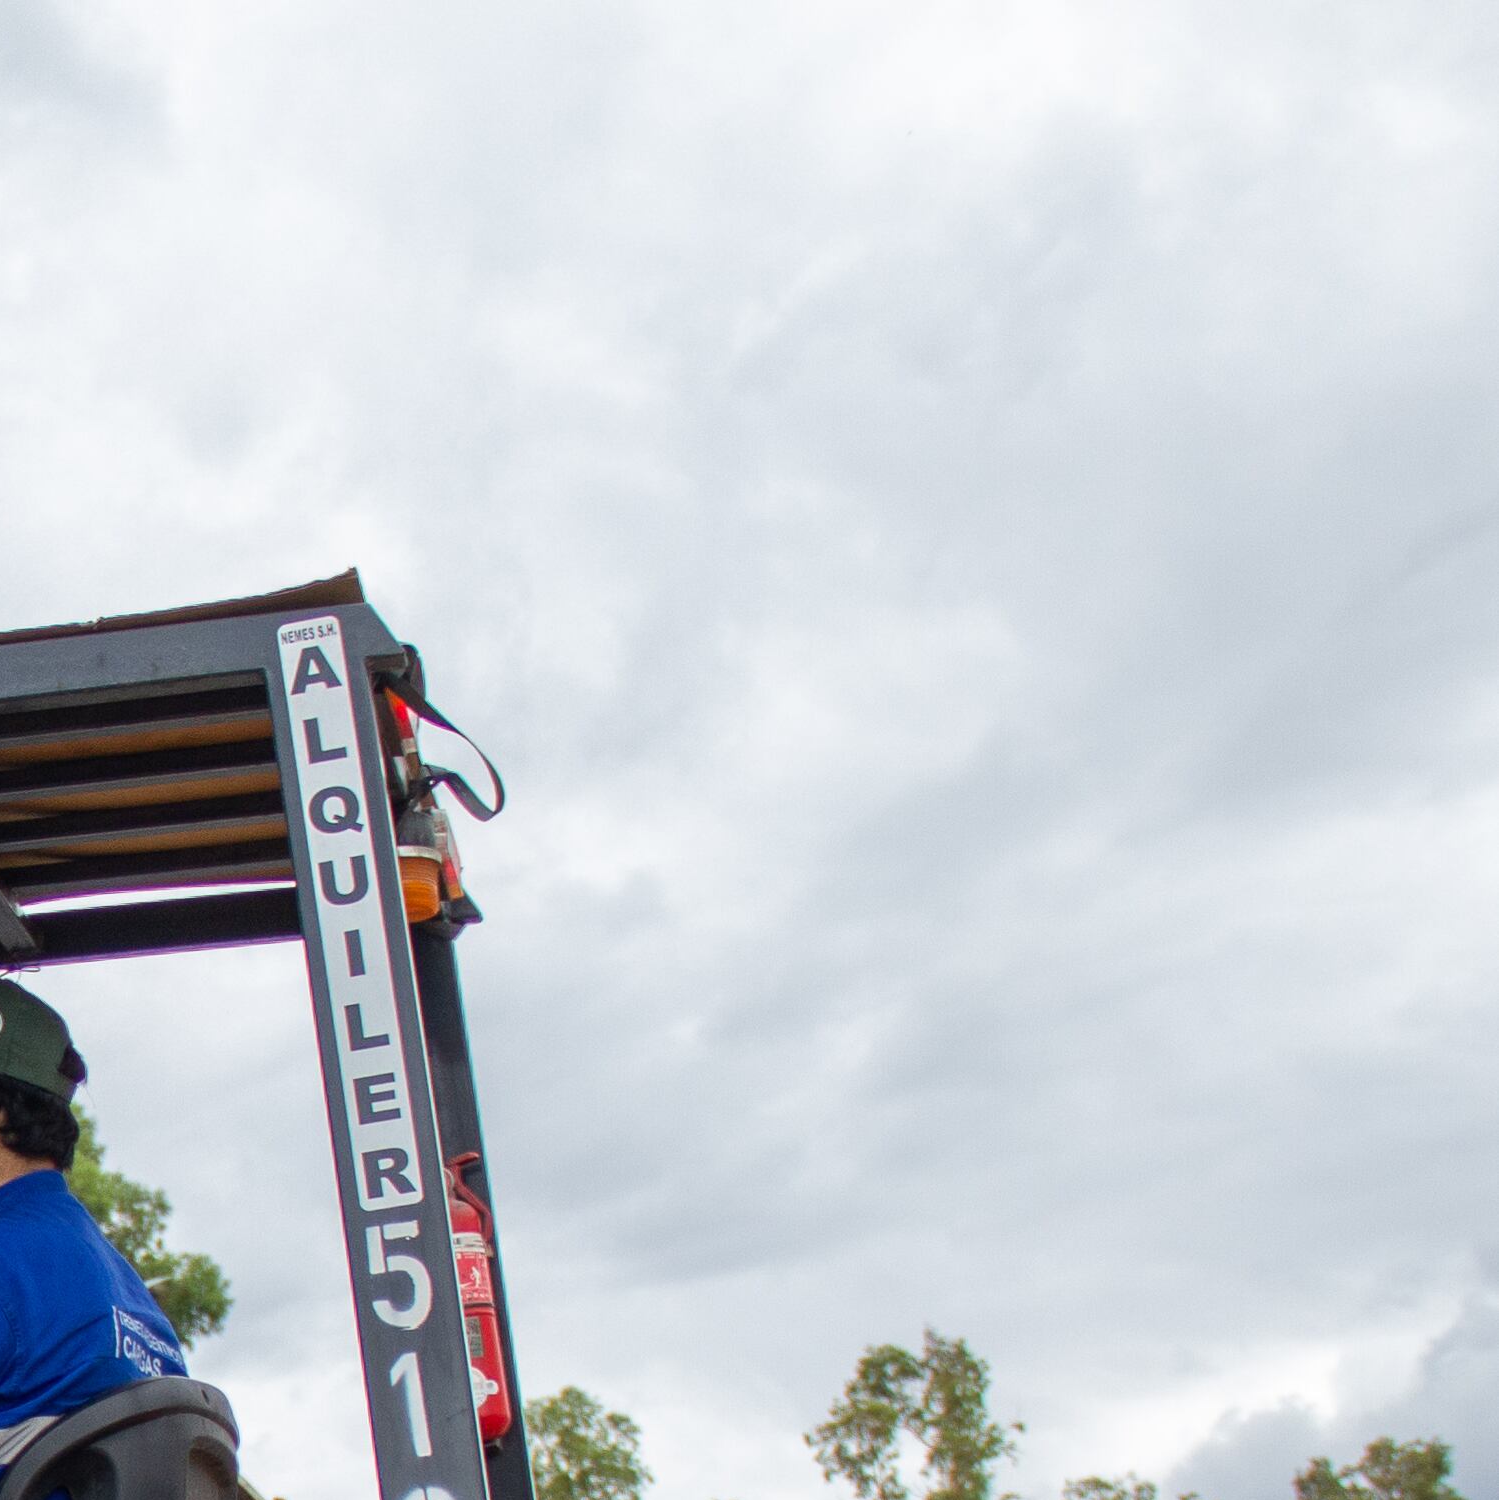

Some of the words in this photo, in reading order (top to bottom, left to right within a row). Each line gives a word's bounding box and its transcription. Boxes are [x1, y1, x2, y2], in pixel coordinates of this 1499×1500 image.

[281, 627, 315, 645] NEMES
[317, 624, 338, 638] S.H.
[289, 645, 417, 1199] ALQUILER
